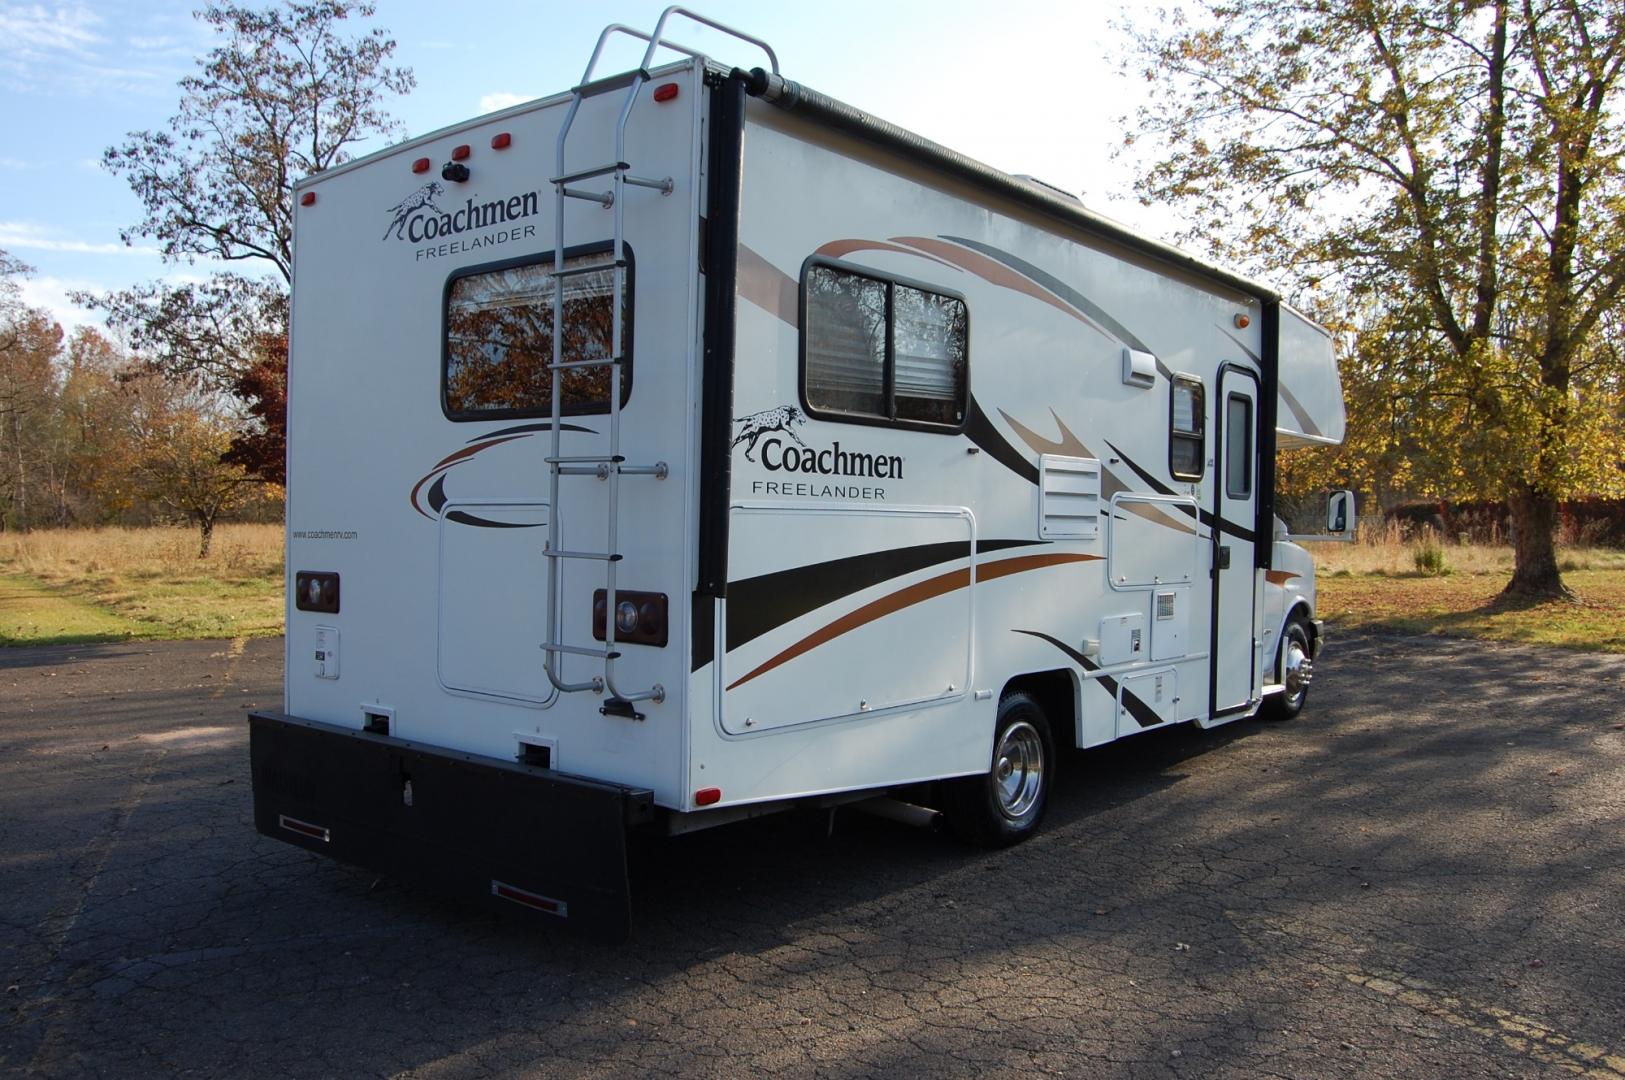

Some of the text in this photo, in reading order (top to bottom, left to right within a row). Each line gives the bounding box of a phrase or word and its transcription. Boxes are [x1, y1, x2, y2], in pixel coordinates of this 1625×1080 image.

[408, 191, 539, 243] Coachmen
[416, 225, 536, 261] FREELANDER
[761, 438, 904, 479] Coachmen
[752, 481, 886, 500] FREELANDER
[293, 530, 358, 540] www.coachmenrv.com
